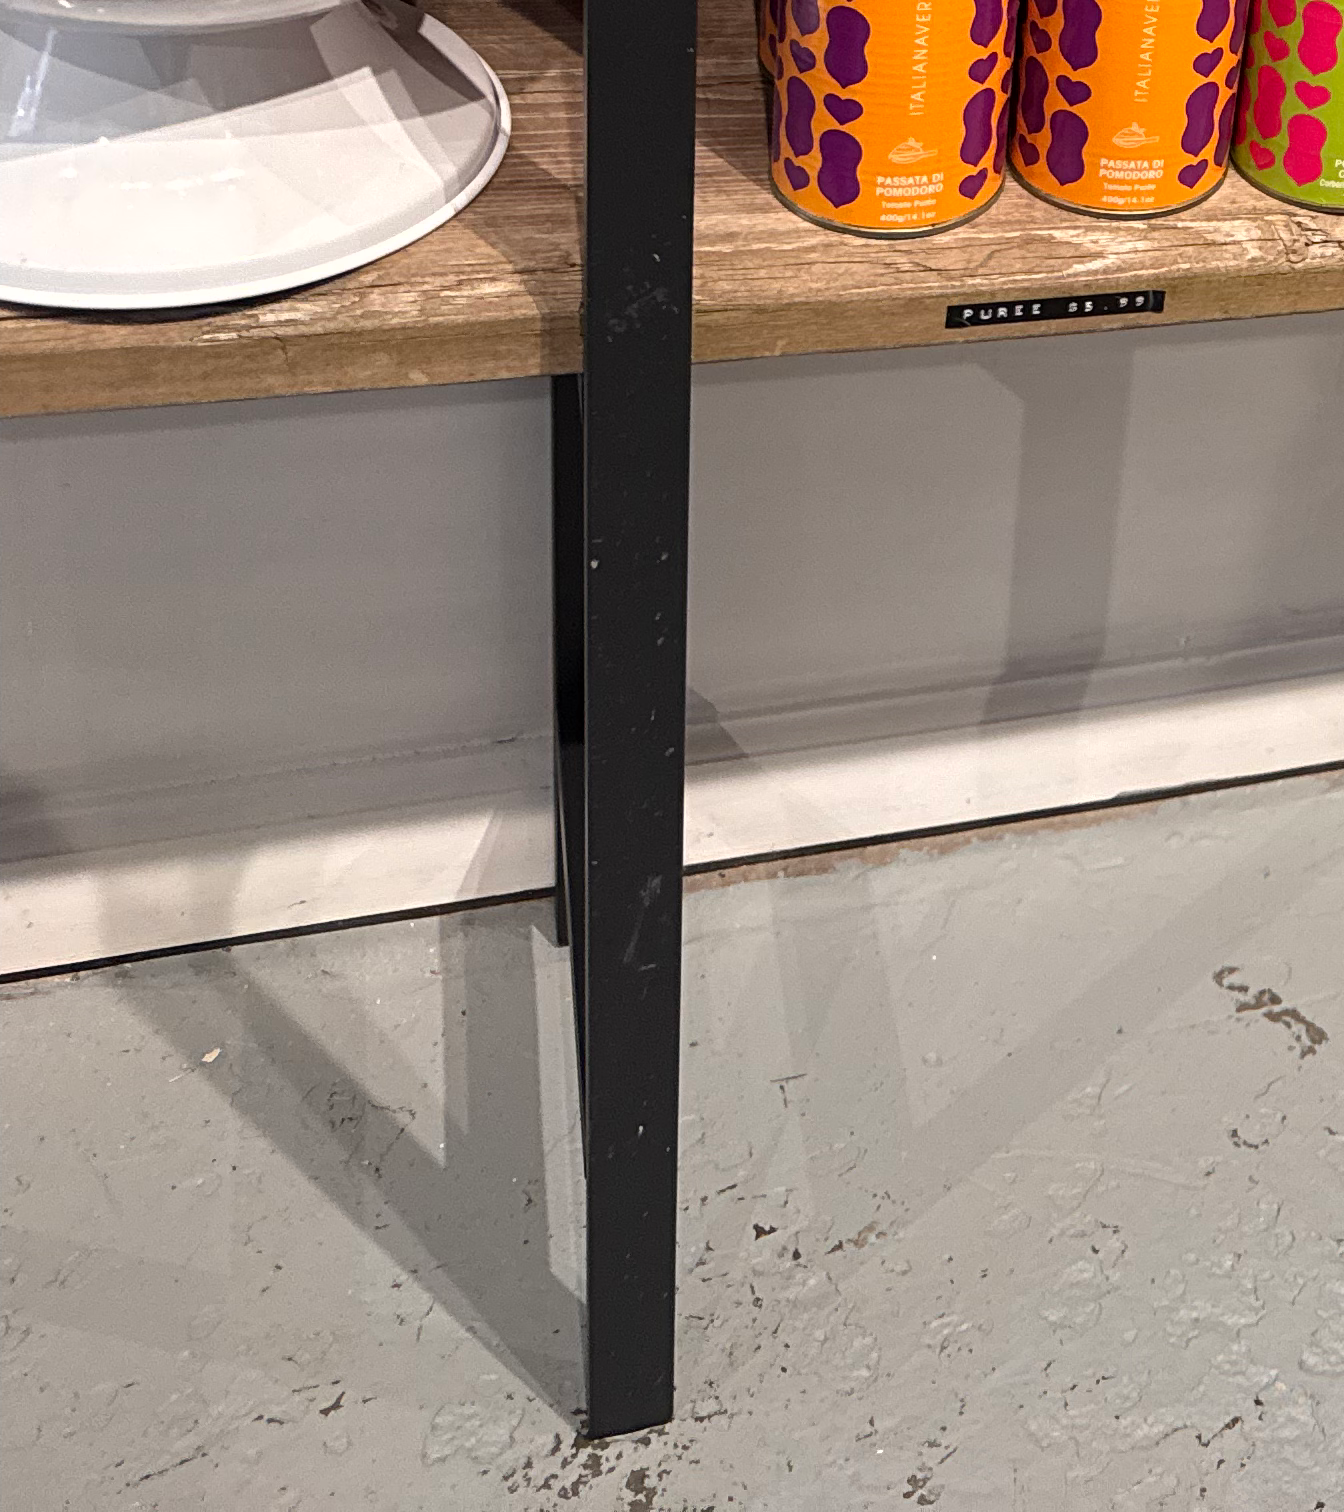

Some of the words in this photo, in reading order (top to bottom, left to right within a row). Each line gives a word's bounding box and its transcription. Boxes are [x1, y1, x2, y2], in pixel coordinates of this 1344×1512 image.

[1101, 159, 1144, 170] PASSATA
[1150, 159, 1164, 168] DI
[877, 175, 925, 186] PASSATA
[931, 173, 943, 182] DI
[1100, 169, 1163, 180] POMODORO
[876, 183, 943, 197] POMODORO
[963, 304, 1041, 320] PUREE
[1068, 296, 1145, 313] $5.99
